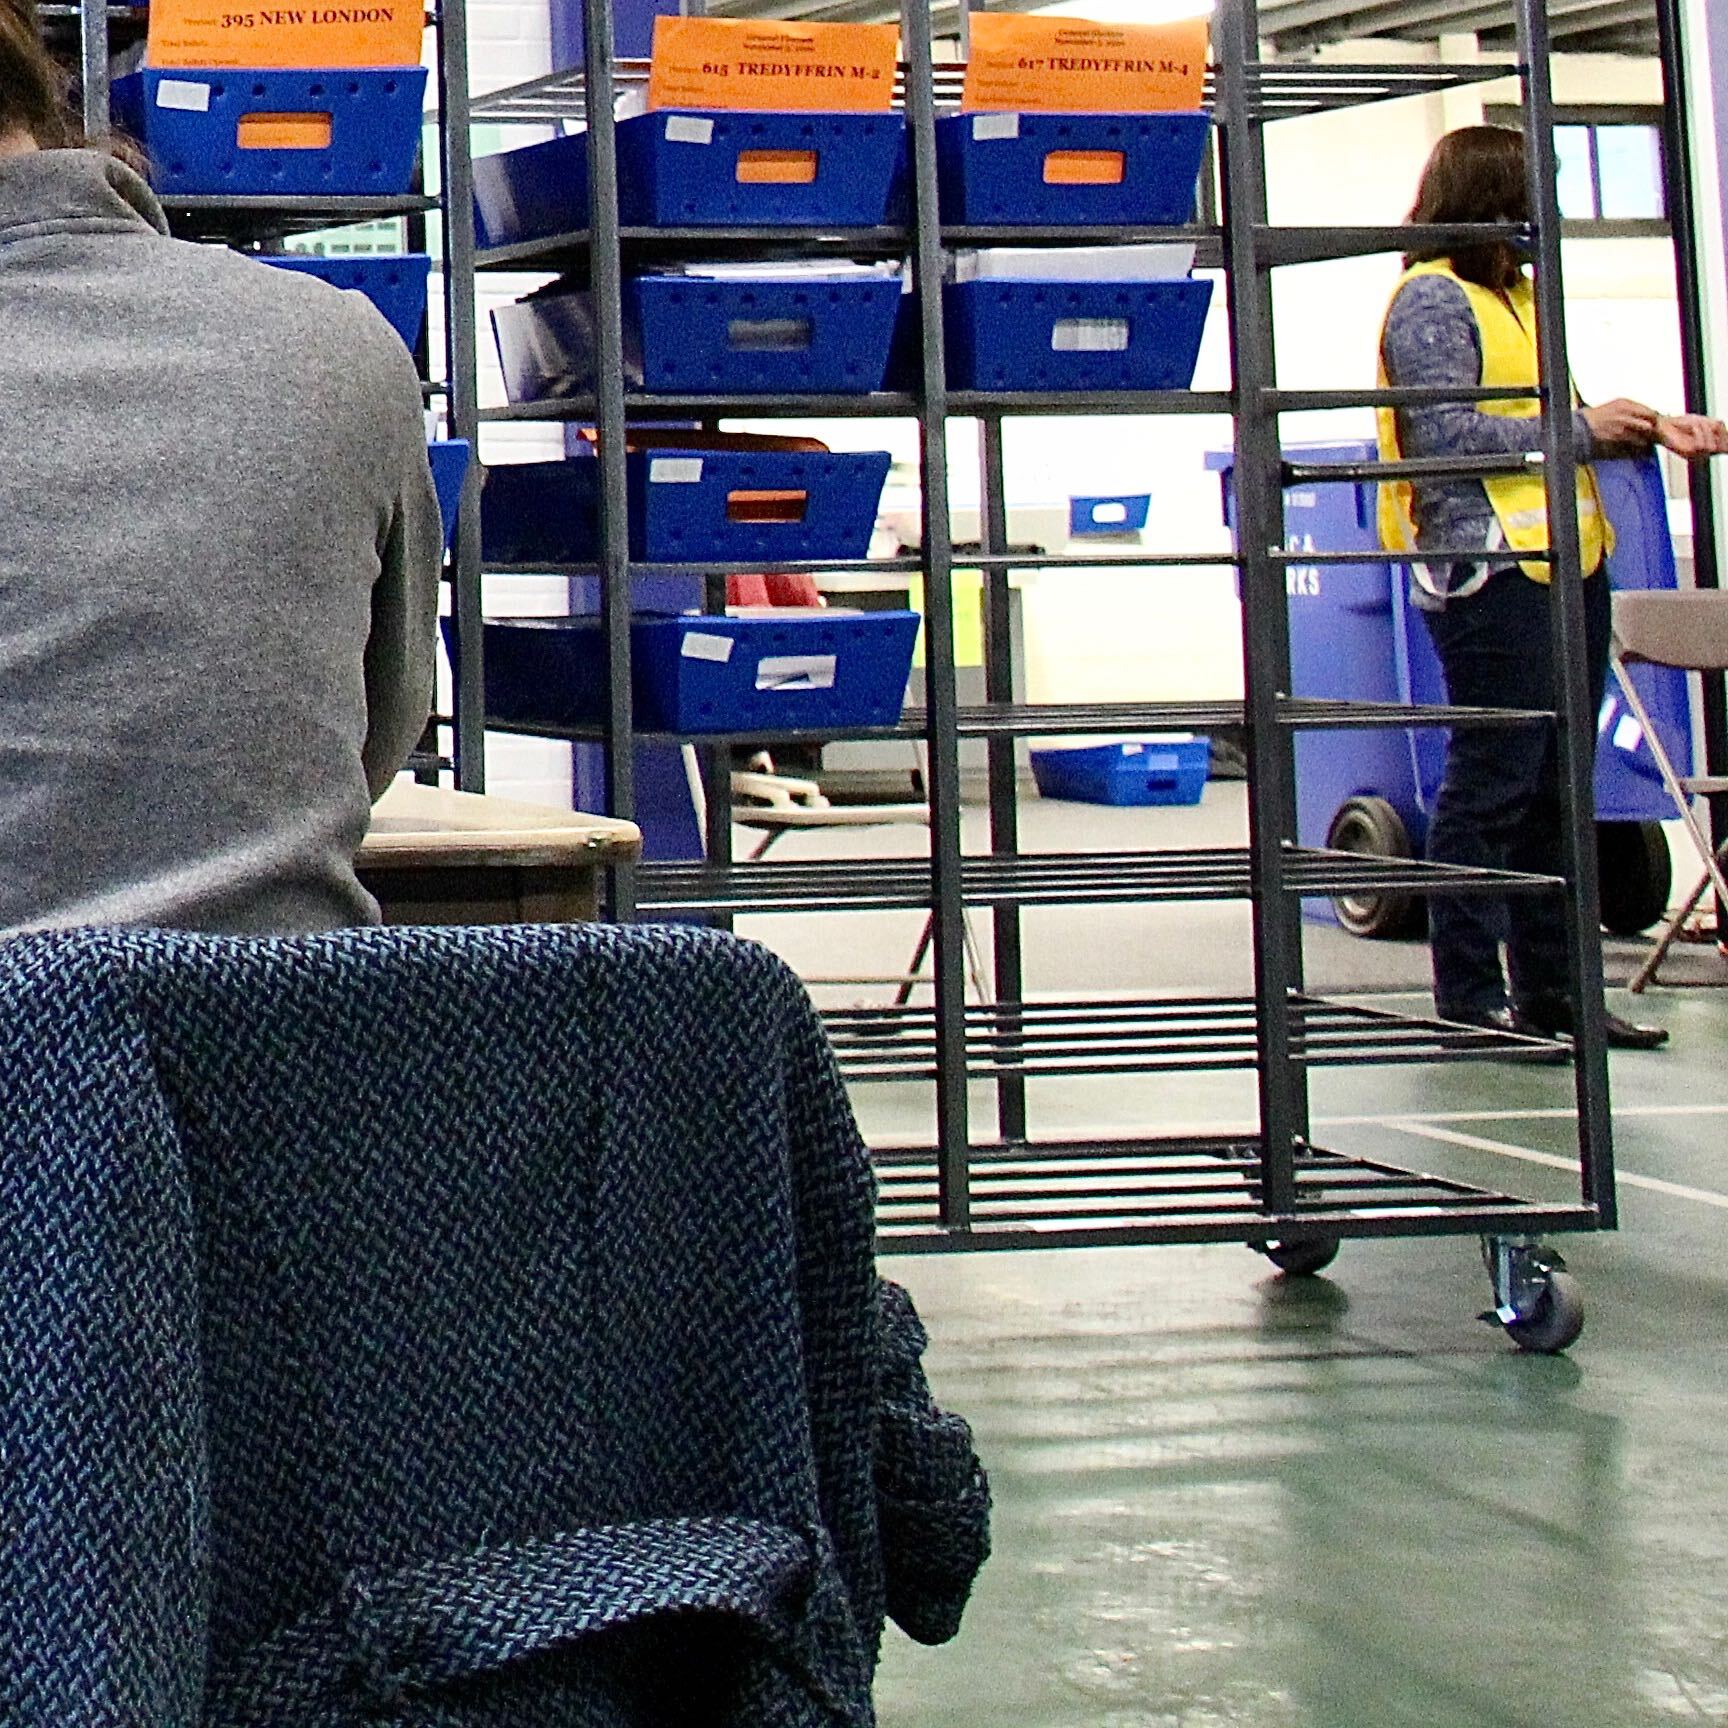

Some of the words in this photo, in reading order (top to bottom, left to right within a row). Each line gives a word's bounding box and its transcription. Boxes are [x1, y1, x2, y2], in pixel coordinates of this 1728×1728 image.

[221, 14, 254, 28] 395
[260, 10, 307, 24] NEW
[312, 8, 395, 23] LONDON
[703, 63, 728, 76] 615
[737, 62, 846, 77] TREDYFFRIN
[850, 66, 880, 79] M-2
[1018, 57, 1044, 69] 617
[1048, 57, 1153, 71] TREDYFFRIN
[1158, 61, 1187, 75] M-4
